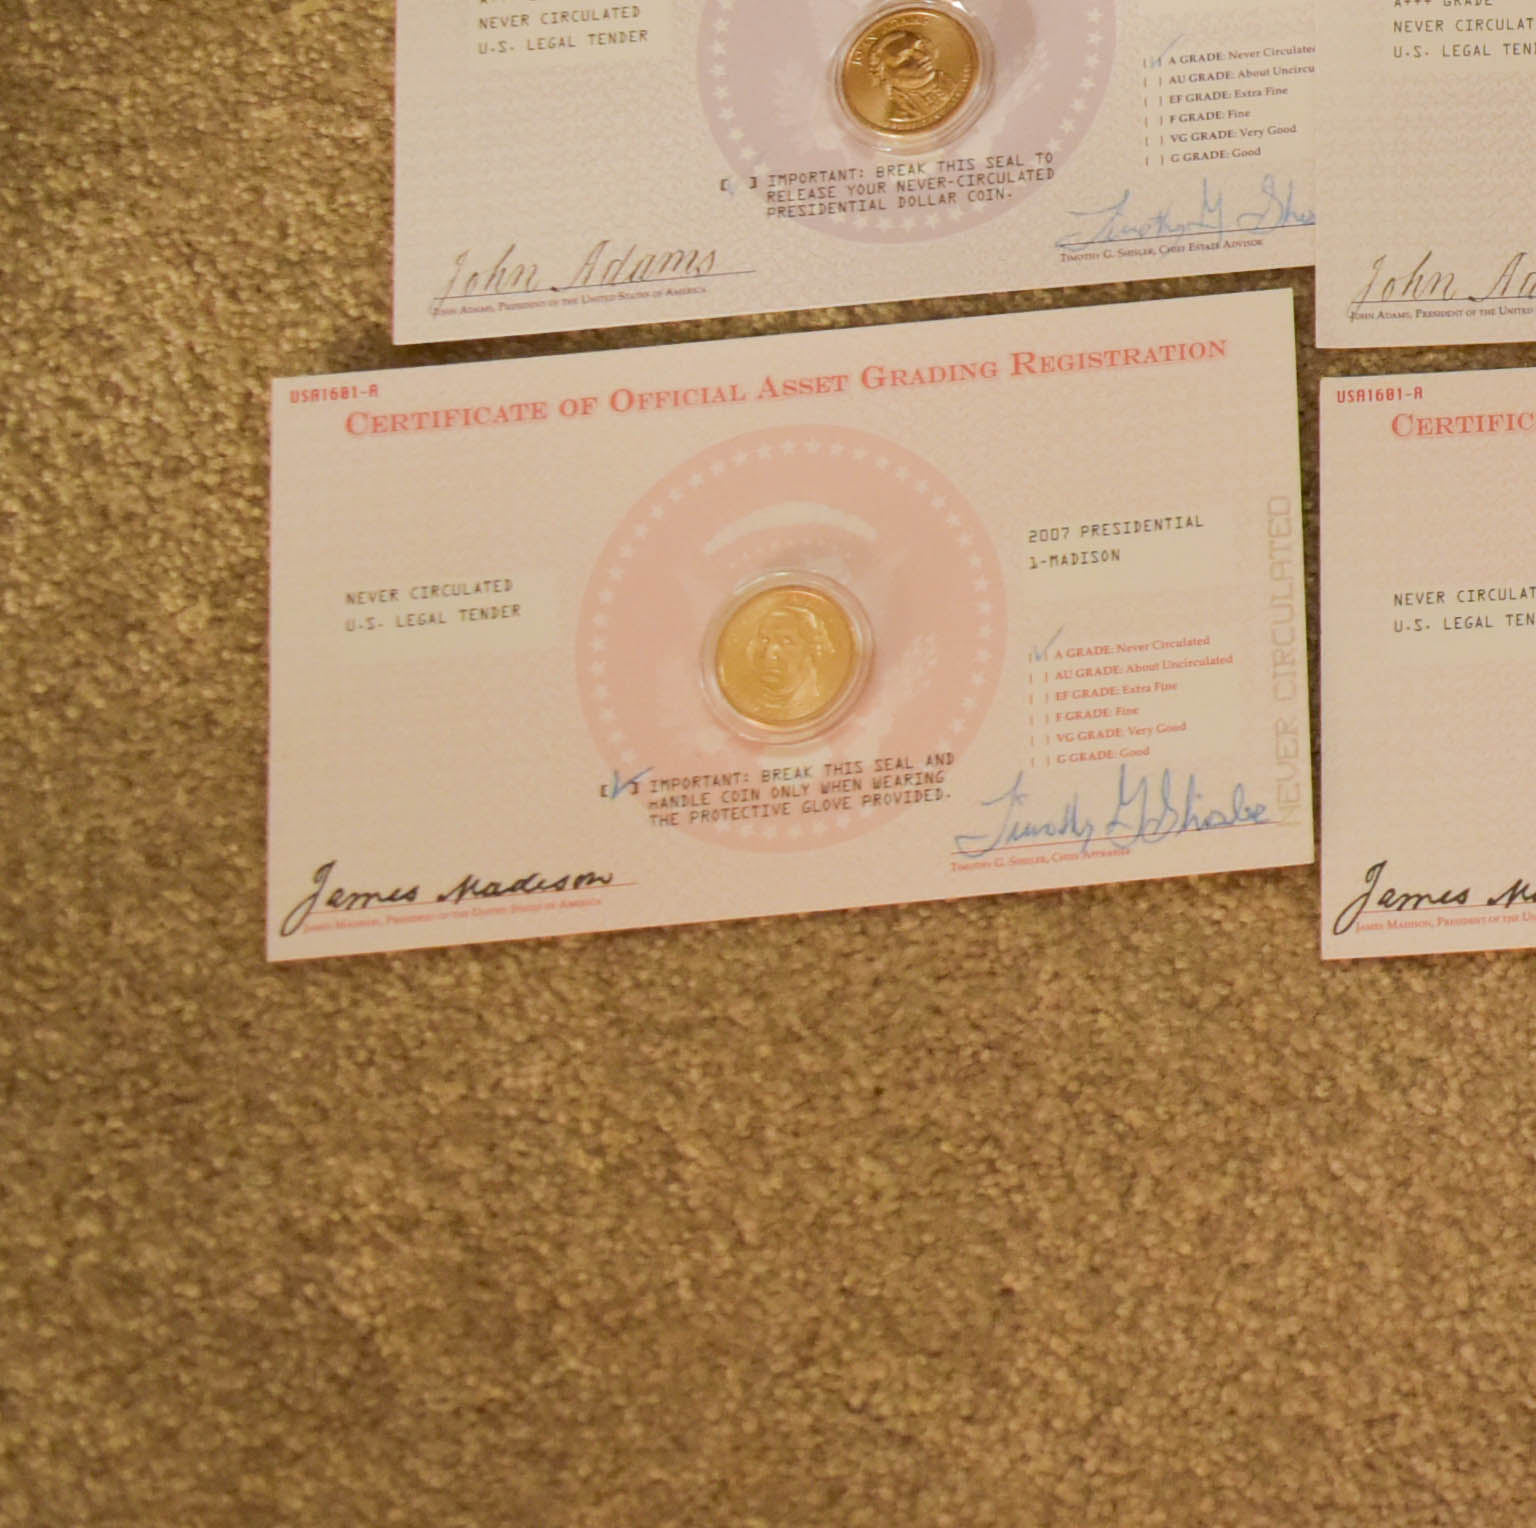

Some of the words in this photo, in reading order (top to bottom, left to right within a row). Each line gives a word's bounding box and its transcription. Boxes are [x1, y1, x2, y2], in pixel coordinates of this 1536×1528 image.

[343, 401, 548, 437] CERTIFICATE
[557, 396, 599, 418] OF
[608, 383, 747, 414] OFFICIAL
[756, 374, 849, 401] ASSET
[858, 361, 999, 391] GRADING
[1010, 339, 1227, 378] REGISTRATION
[1028, 526, 1070, 544] 2007
[1079, 514, 1204, 538] PRESIDENTIAL
[1029, 548, 1120, 570] 1-MADISON
[344, 588, 399, 605] NEVER
[409, 578, 513, 600] CIRCULATED
[1393, 618, 1431, 634] U.S.
[1442, 615, 1494, 631] LEGAL
